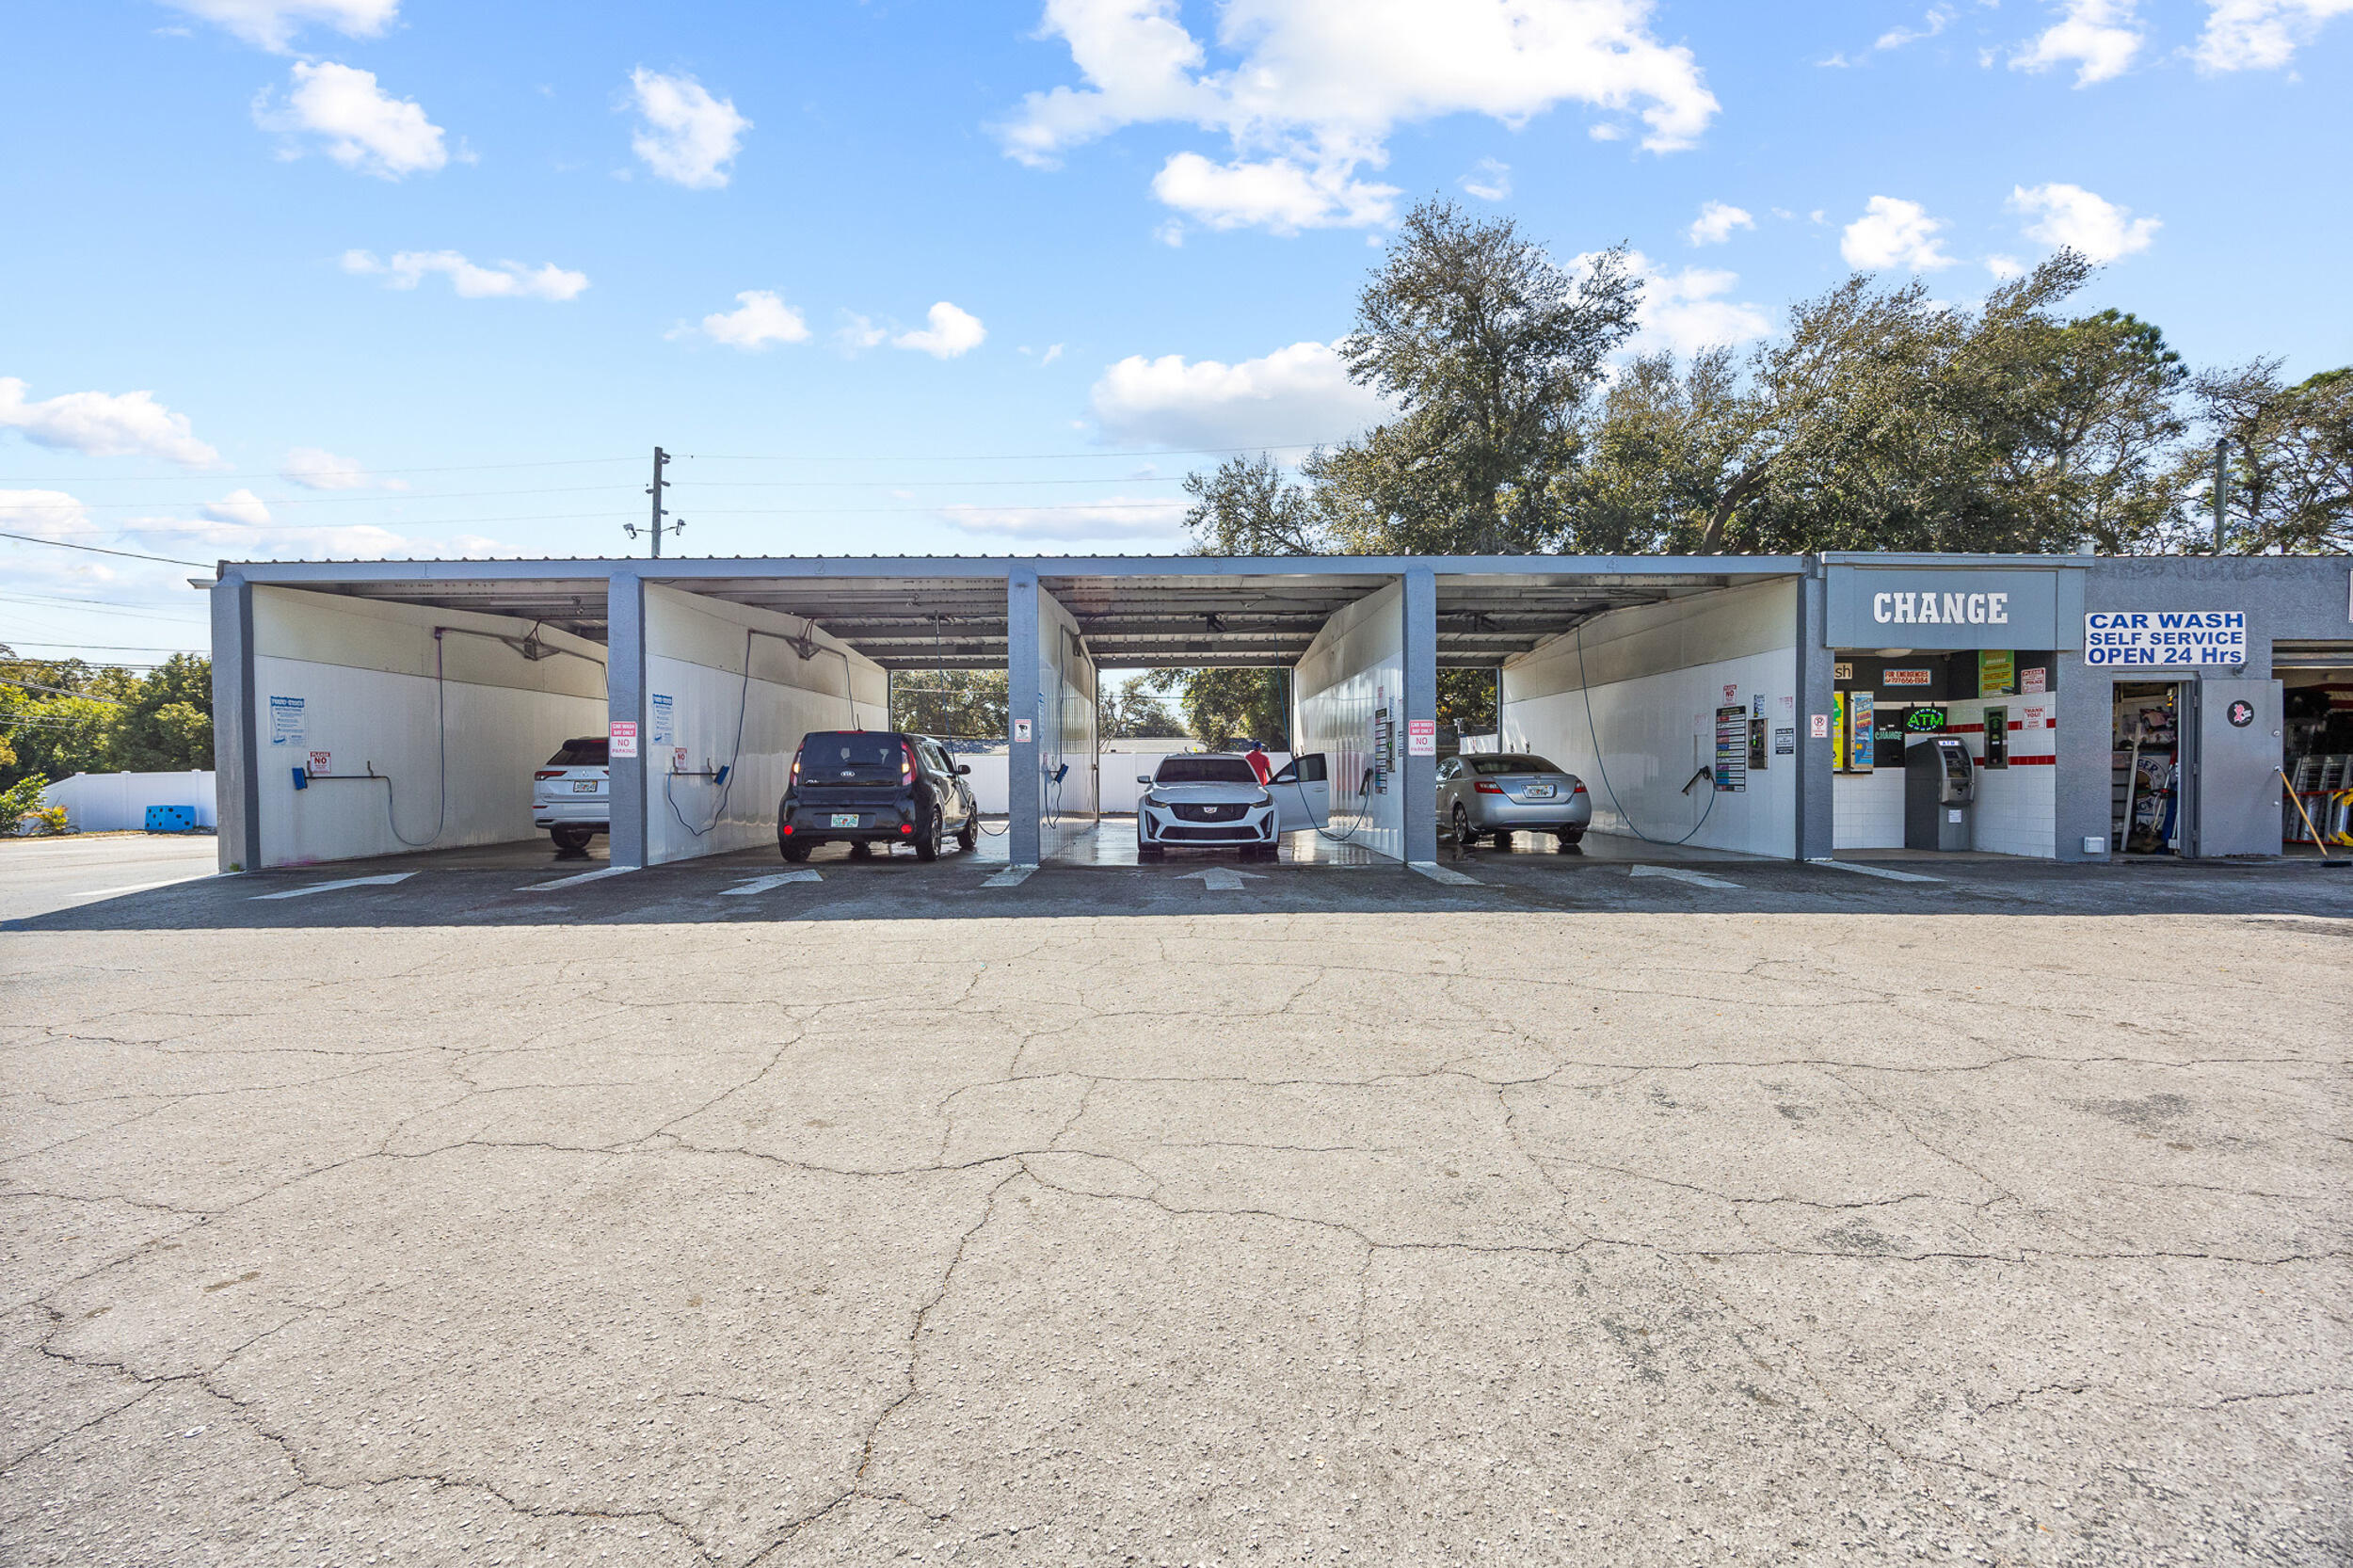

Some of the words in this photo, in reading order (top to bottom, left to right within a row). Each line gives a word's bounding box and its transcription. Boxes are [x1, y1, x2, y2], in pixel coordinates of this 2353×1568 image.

[1873, 592, 2008, 623] CHANGE
[2089, 615, 2149, 629] CAR
[2158, 614, 2243, 629] WASH
[2089, 632, 2142, 646] SELF
[2150, 632, 2243, 646] SERVICE
[2089, 648, 2155, 664] OPEN
[2164, 648, 2192, 664] 24
[2201, 648, 2242, 664] Hrs
[1907, 713, 1945, 727] ATM
[1875, 731, 1902, 740] CHANGE
